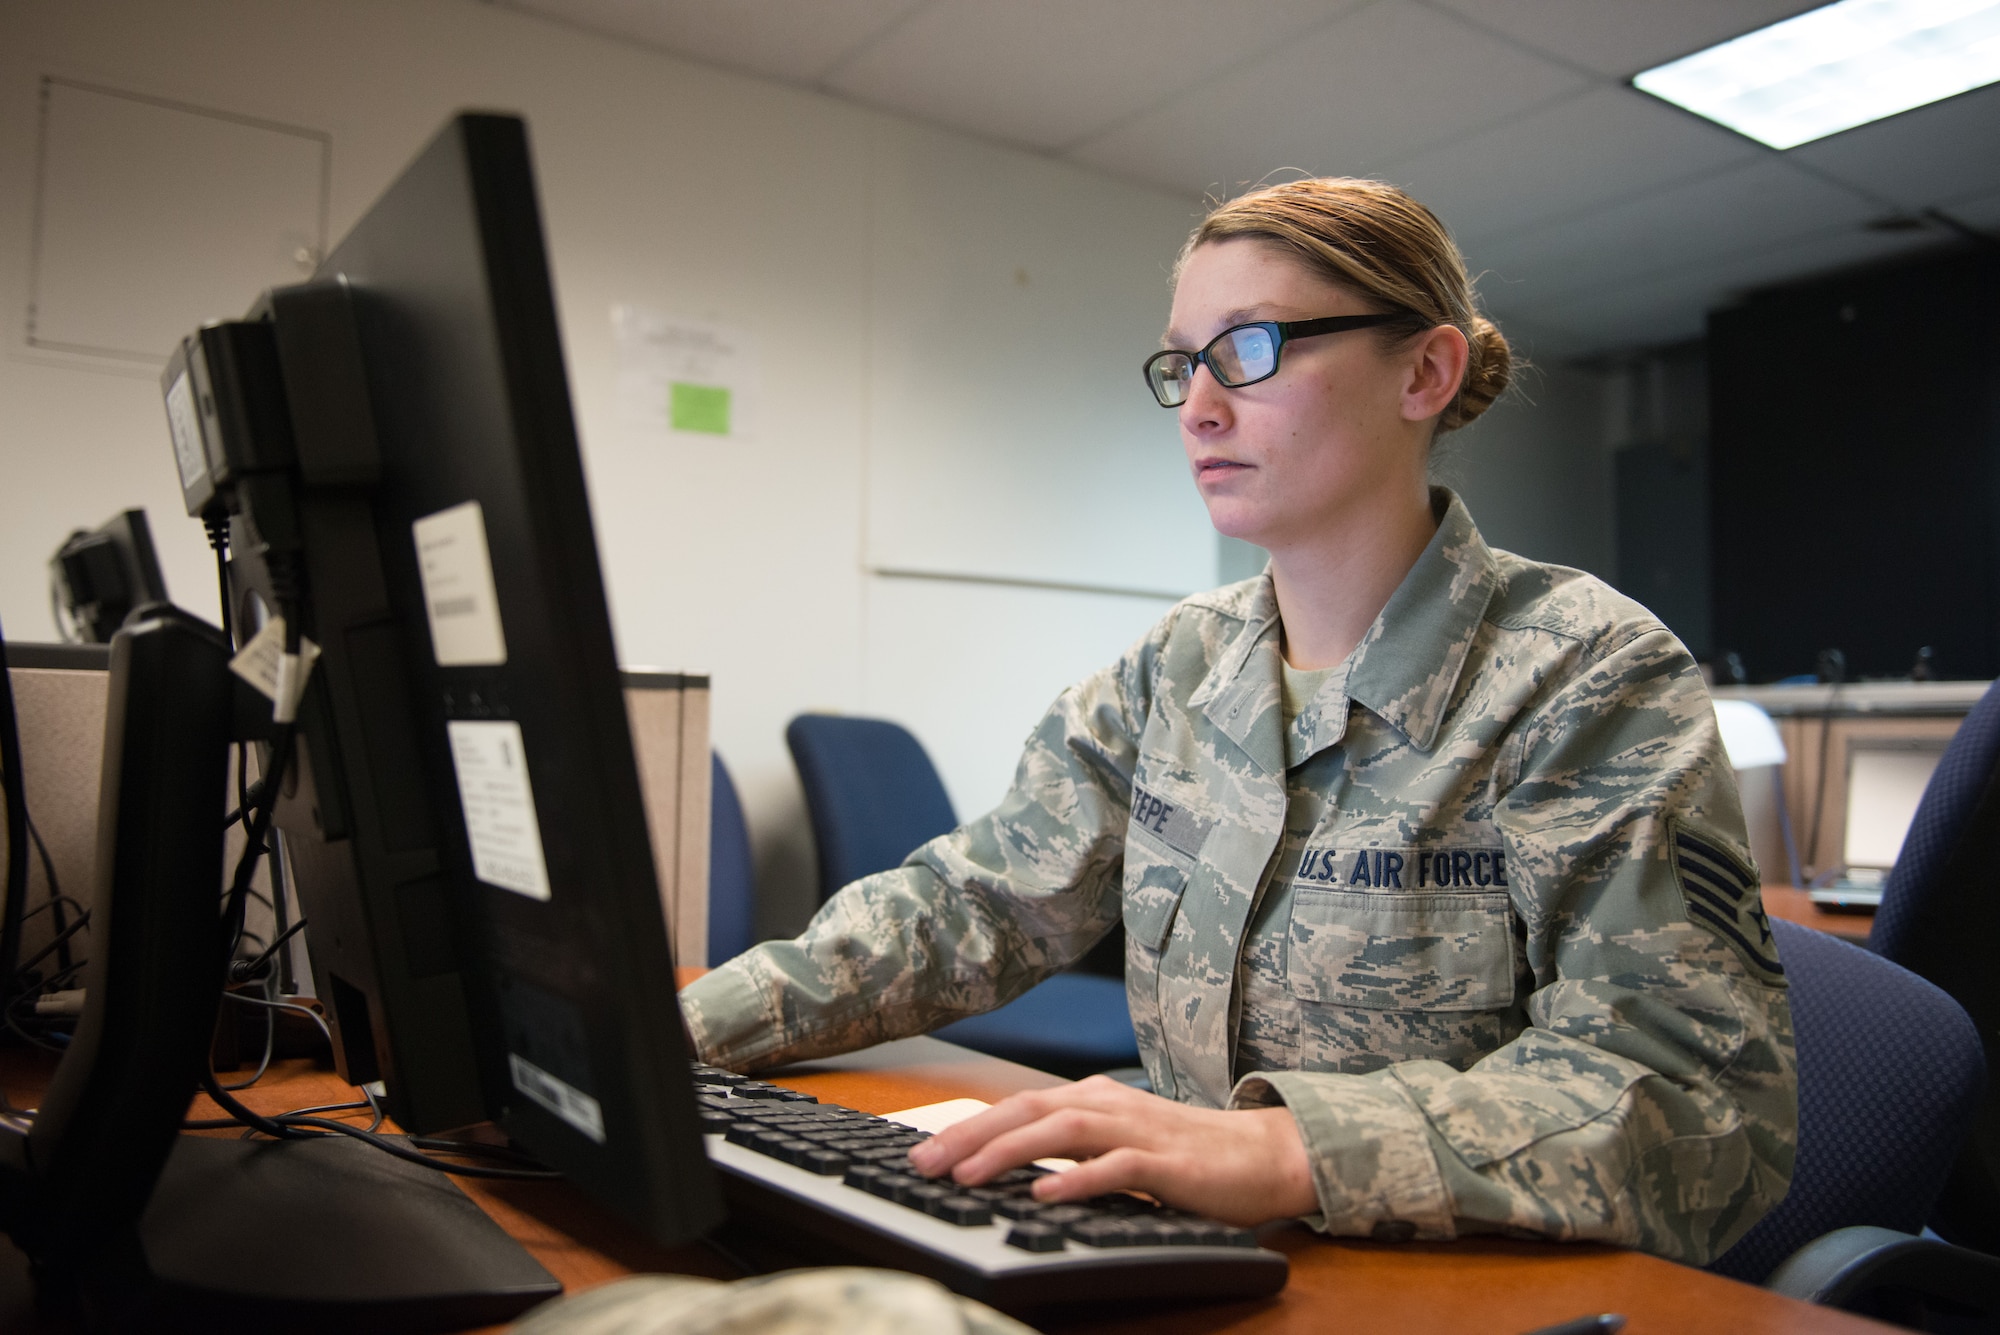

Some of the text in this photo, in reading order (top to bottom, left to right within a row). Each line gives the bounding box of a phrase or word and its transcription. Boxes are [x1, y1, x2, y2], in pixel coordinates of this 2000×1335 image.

[1131, 786, 1174, 834] TEPE
[1299, 850, 1508, 888] U.S. AIR FORCE
